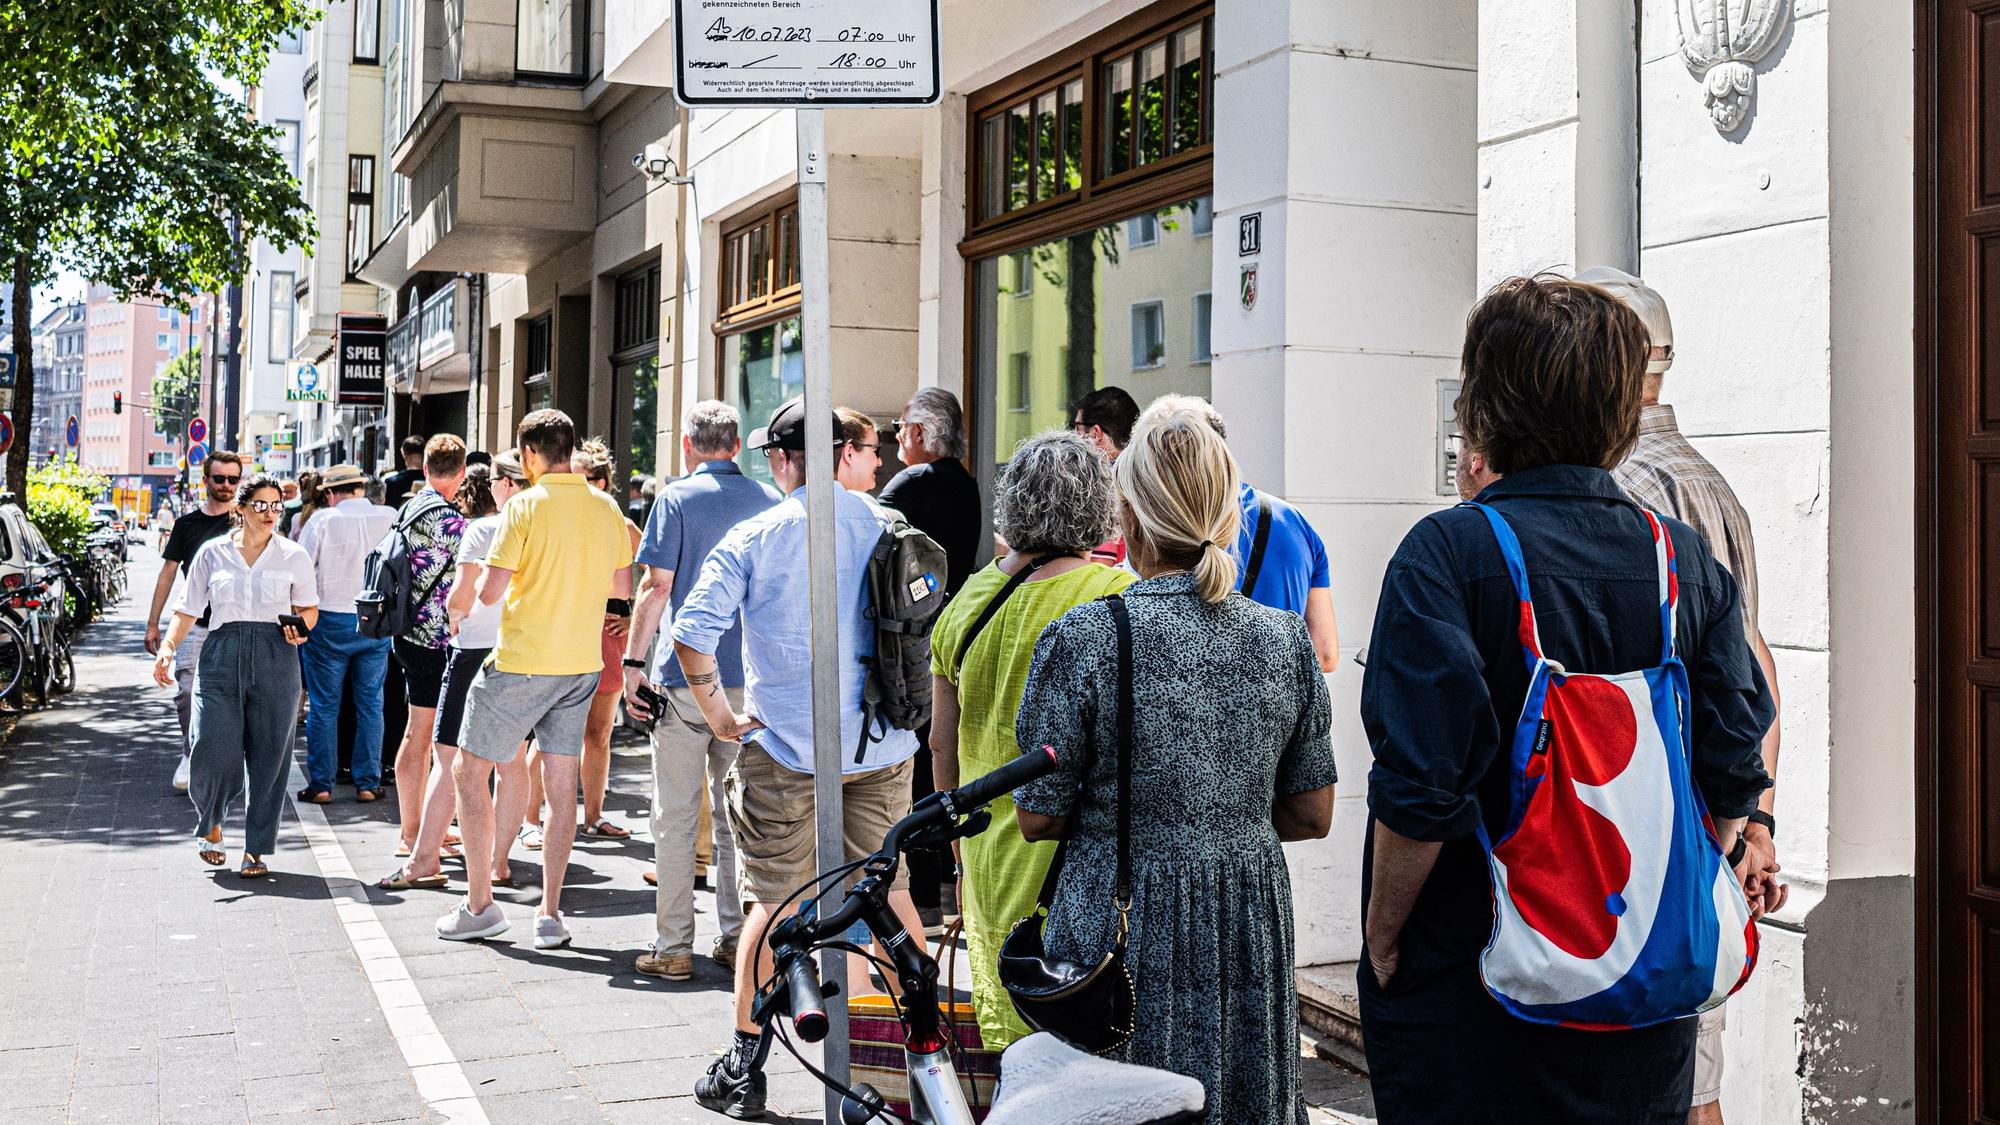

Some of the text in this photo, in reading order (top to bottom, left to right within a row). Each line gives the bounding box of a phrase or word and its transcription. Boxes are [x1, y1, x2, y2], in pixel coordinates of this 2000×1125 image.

[702, 1, 770, 9] gekennzeichneten
[705, 16, 732, 34] Ab
[732, 26, 811, 42] 10.07.2023
[838, 27, 884, 42] 07:00
[898, 33, 916, 42] Uhr
[830, 52, 886, 68] 18:00
[898, 60, 917, 69] Uhr
[1242, 218, 1256, 251] 31
[346, 346, 381, 360] SPIEL
[345, 365, 381, 379] HALLE
[1536, 722, 1548, 751] notabag
